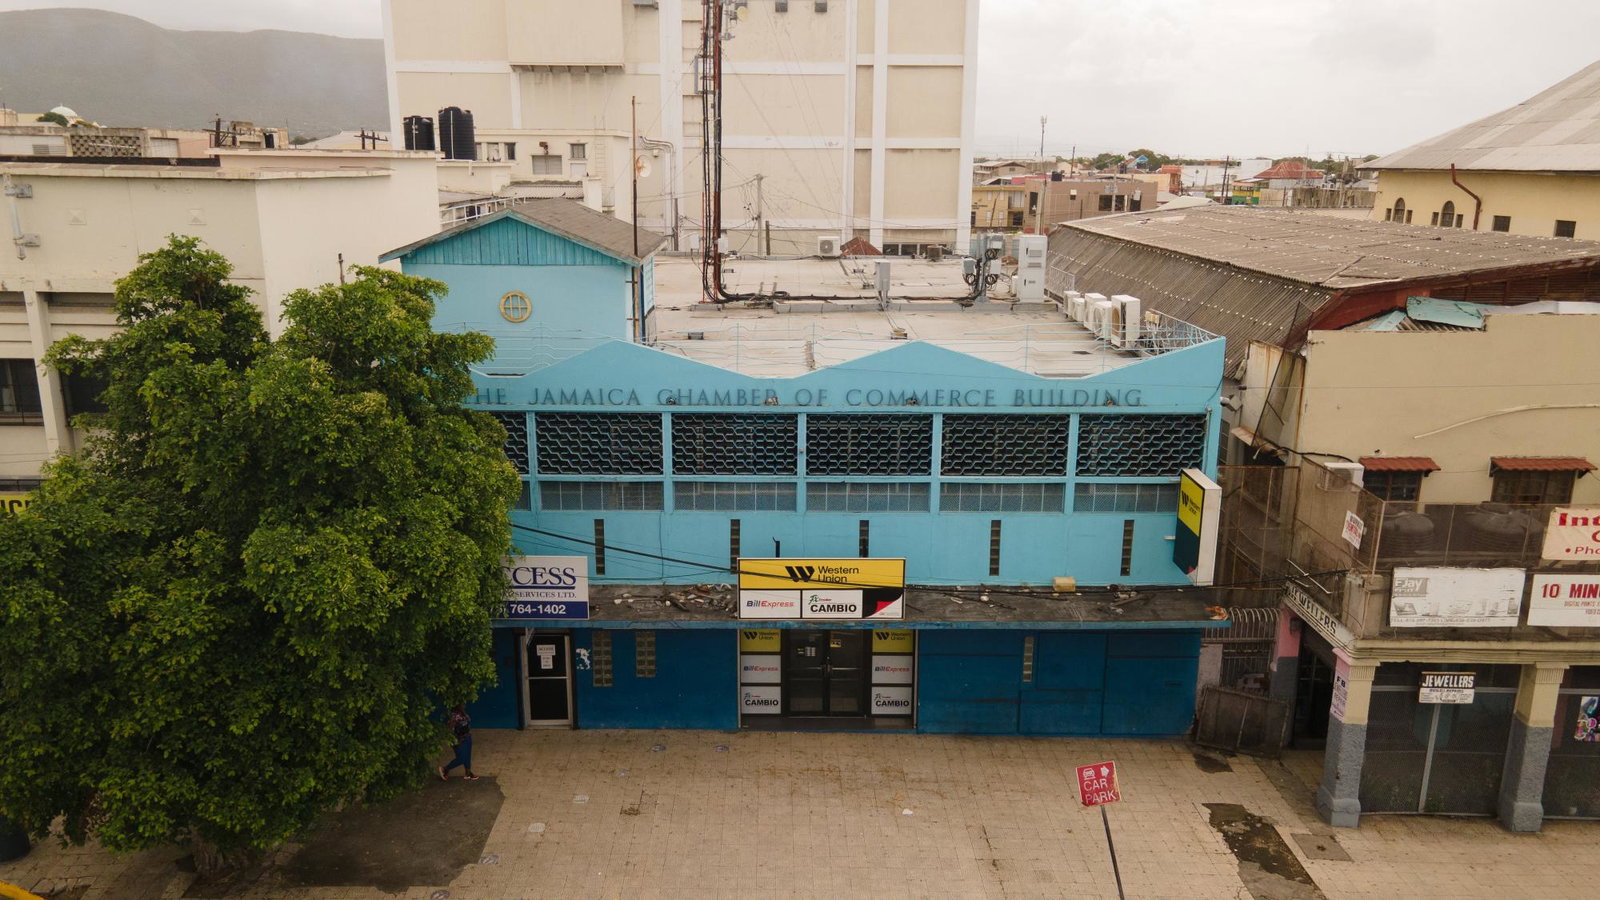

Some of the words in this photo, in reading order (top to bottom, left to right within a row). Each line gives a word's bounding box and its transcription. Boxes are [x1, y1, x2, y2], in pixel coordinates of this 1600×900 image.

[476, 388, 506, 404] HE
[529, 388, 641, 406] JAMAICA
[657, 388, 779, 406] CHAMBER
[794, 389, 828, 406] OF
[846, 389, 996, 407] COMMERCE
[1014, 389, 1142, 407] BUILDING
[501, 566, 577, 586] CESS
[817, 566, 859, 575] Western
[817, 574, 848, 583] Union
[515, 591, 556, 599] SERVICES
[557, 591, 577, 599] LTD.
[1541, 584, 1560, 598] 10
[1569, 584, 1600, 598] MIN
[510, 604, 567, 615] 764-1402
[746, 600, 794, 608] BillExpress
[810, 604, 857, 613] CAMBIO
[1422, 675, 1475, 688] JEWELLERS
[1083, 778, 1108, 791] CAR
[1085, 790, 1117, 804] PARK
